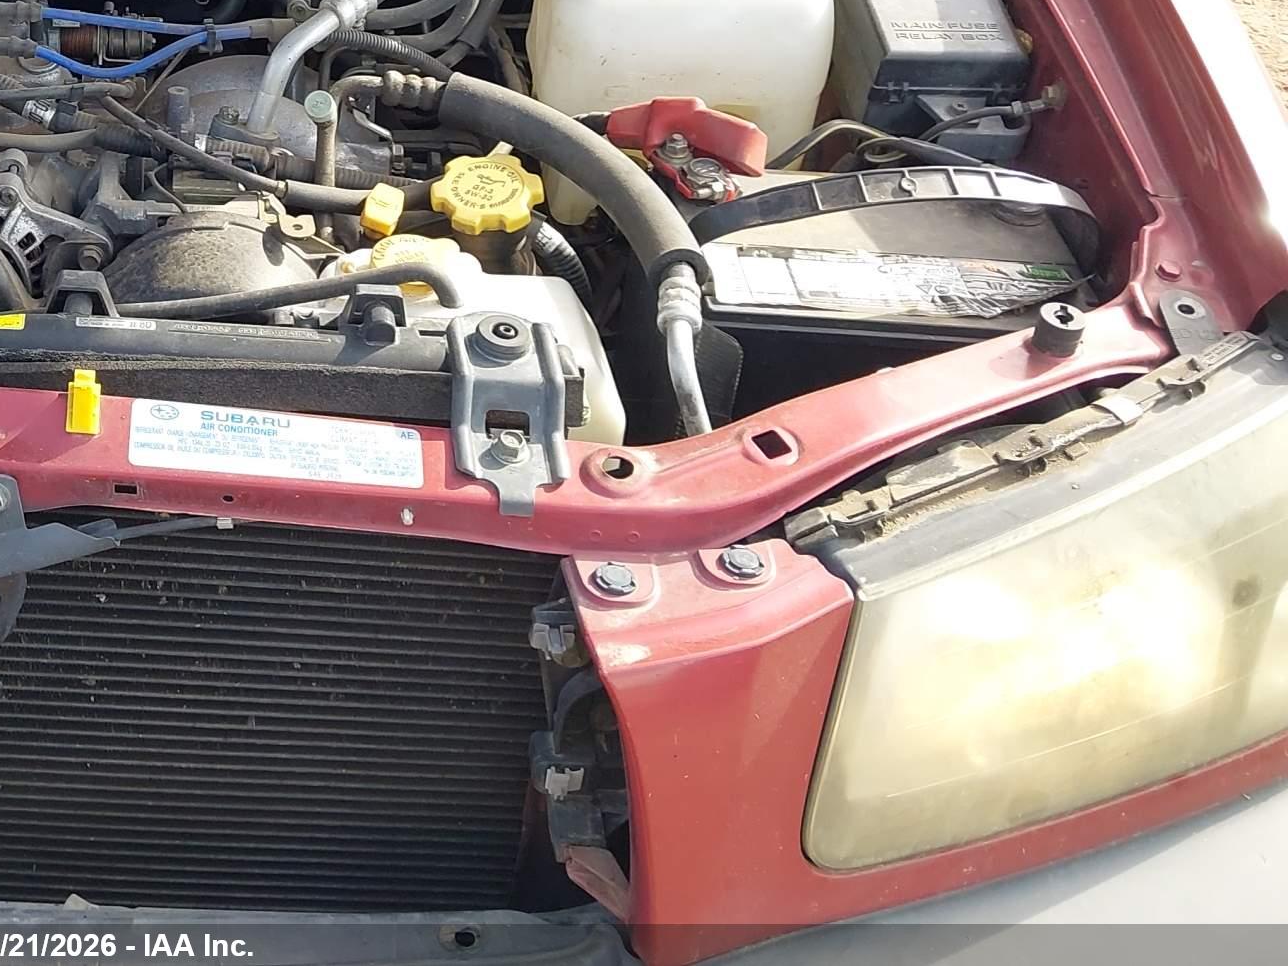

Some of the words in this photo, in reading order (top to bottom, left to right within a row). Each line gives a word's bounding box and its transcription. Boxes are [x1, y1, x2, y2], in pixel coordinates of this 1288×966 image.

[890, 21, 944, 29] MAIN
[947, 22, 1000, 30] FUSE
[895, 32, 953, 40] RELAY
[961, 33, 1005, 41] BOX
[467, 164, 508, 172] ENGINE
[507, 171, 520, 183] OIL
[200, 410, 291, 429] SUBARU
[200, 422, 215, 431] AIR
[218, 423, 278, 437] CONDITIONER
[400, 431, 414, 440] AE
